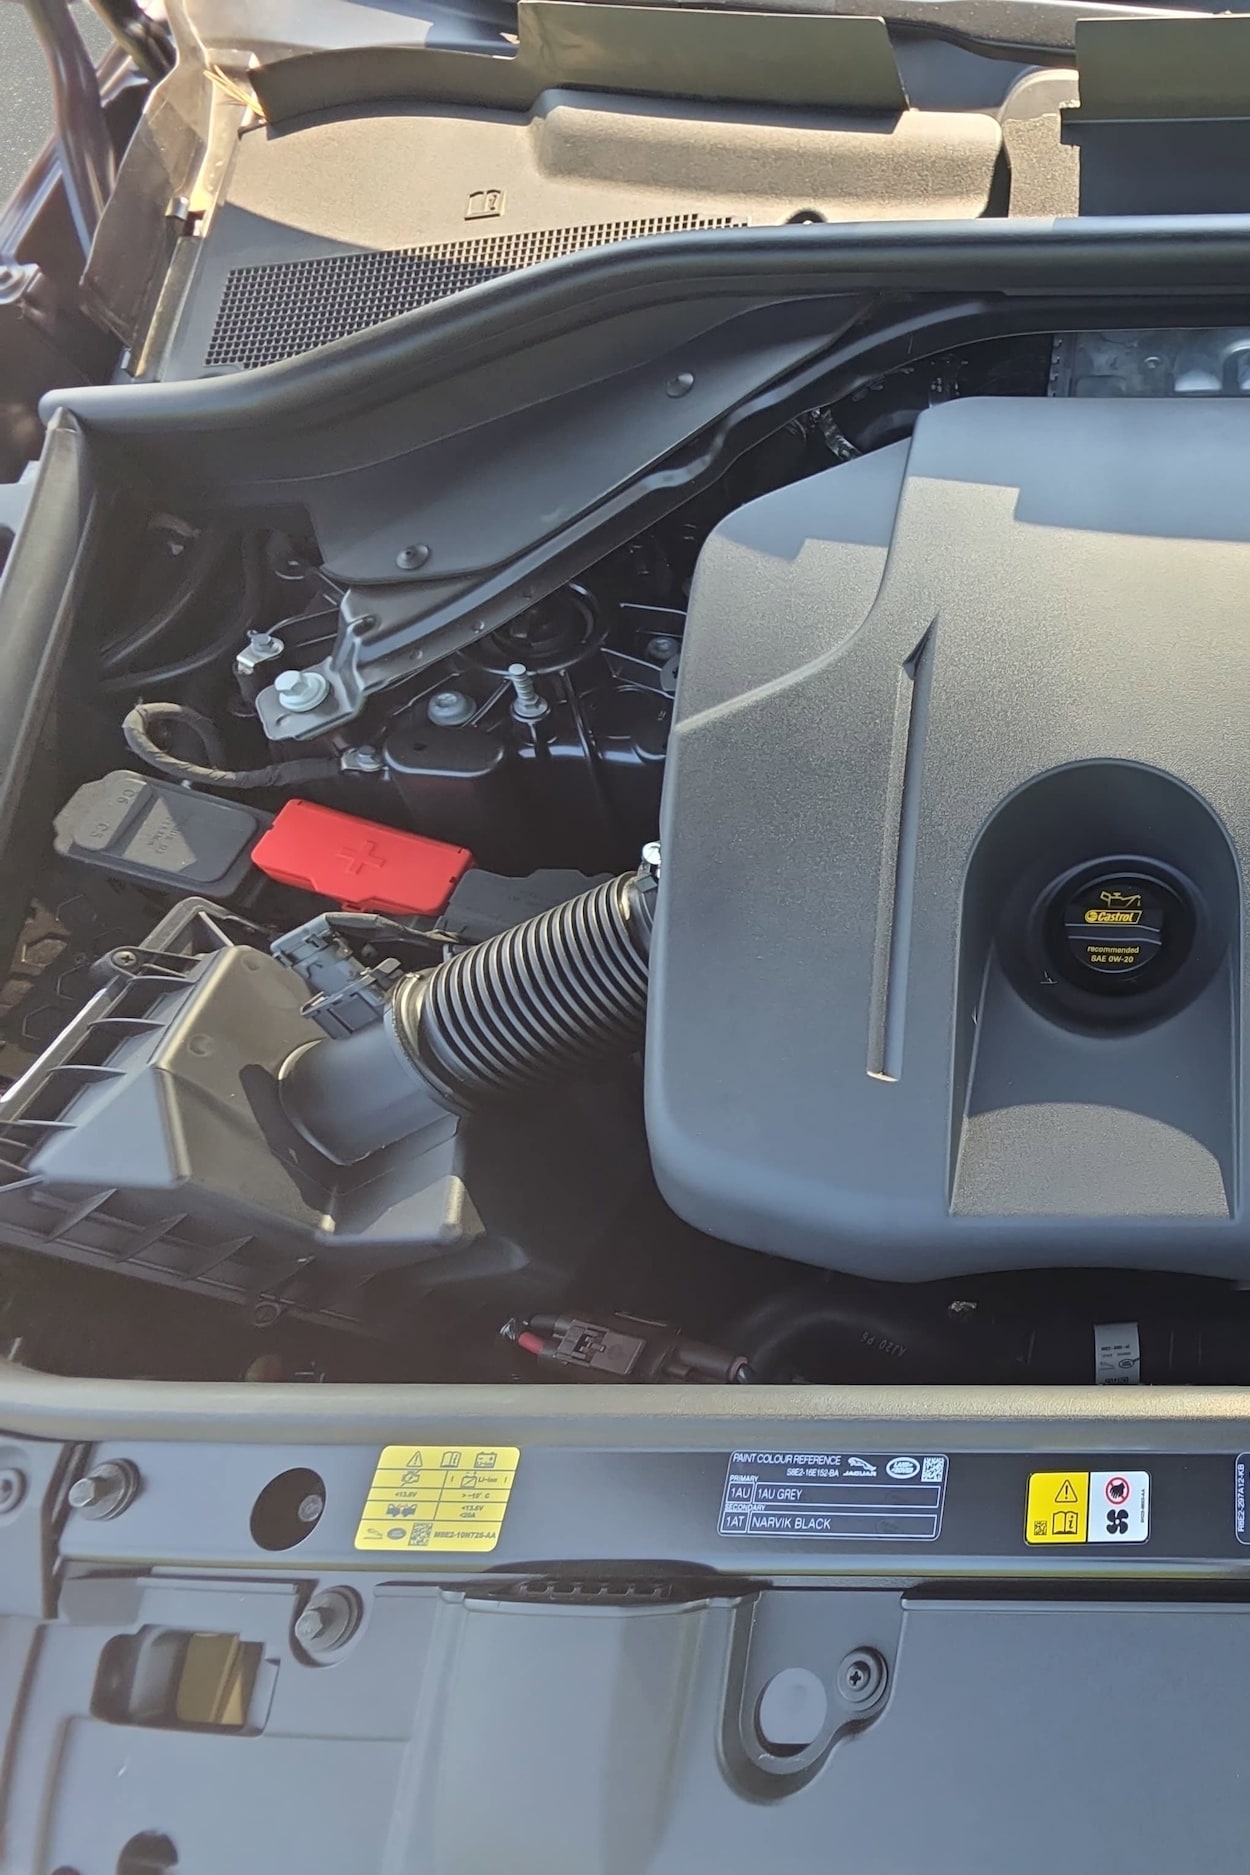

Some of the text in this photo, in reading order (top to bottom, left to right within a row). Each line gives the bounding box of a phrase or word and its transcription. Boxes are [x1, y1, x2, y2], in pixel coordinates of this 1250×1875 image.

[1098, 912, 1134, 922] Castrol
[1087, 945, 1140, 954] recommended
[1091, 955, 1134, 964] SAE 0W-20
[733, 1454, 841, 1465] PAINT COLOUR REFERENCE
[729, 1474, 758, 1482] PRIMARY
[731, 1488, 750, 1498] 1AU
[757, 1488, 802, 1500] 1AU GREY
[724, 1503, 766, 1511] SECONDARY
[726, 1515, 745, 1527] 1AT
[751, 1516, 831, 1530] NARVIK BLACK
